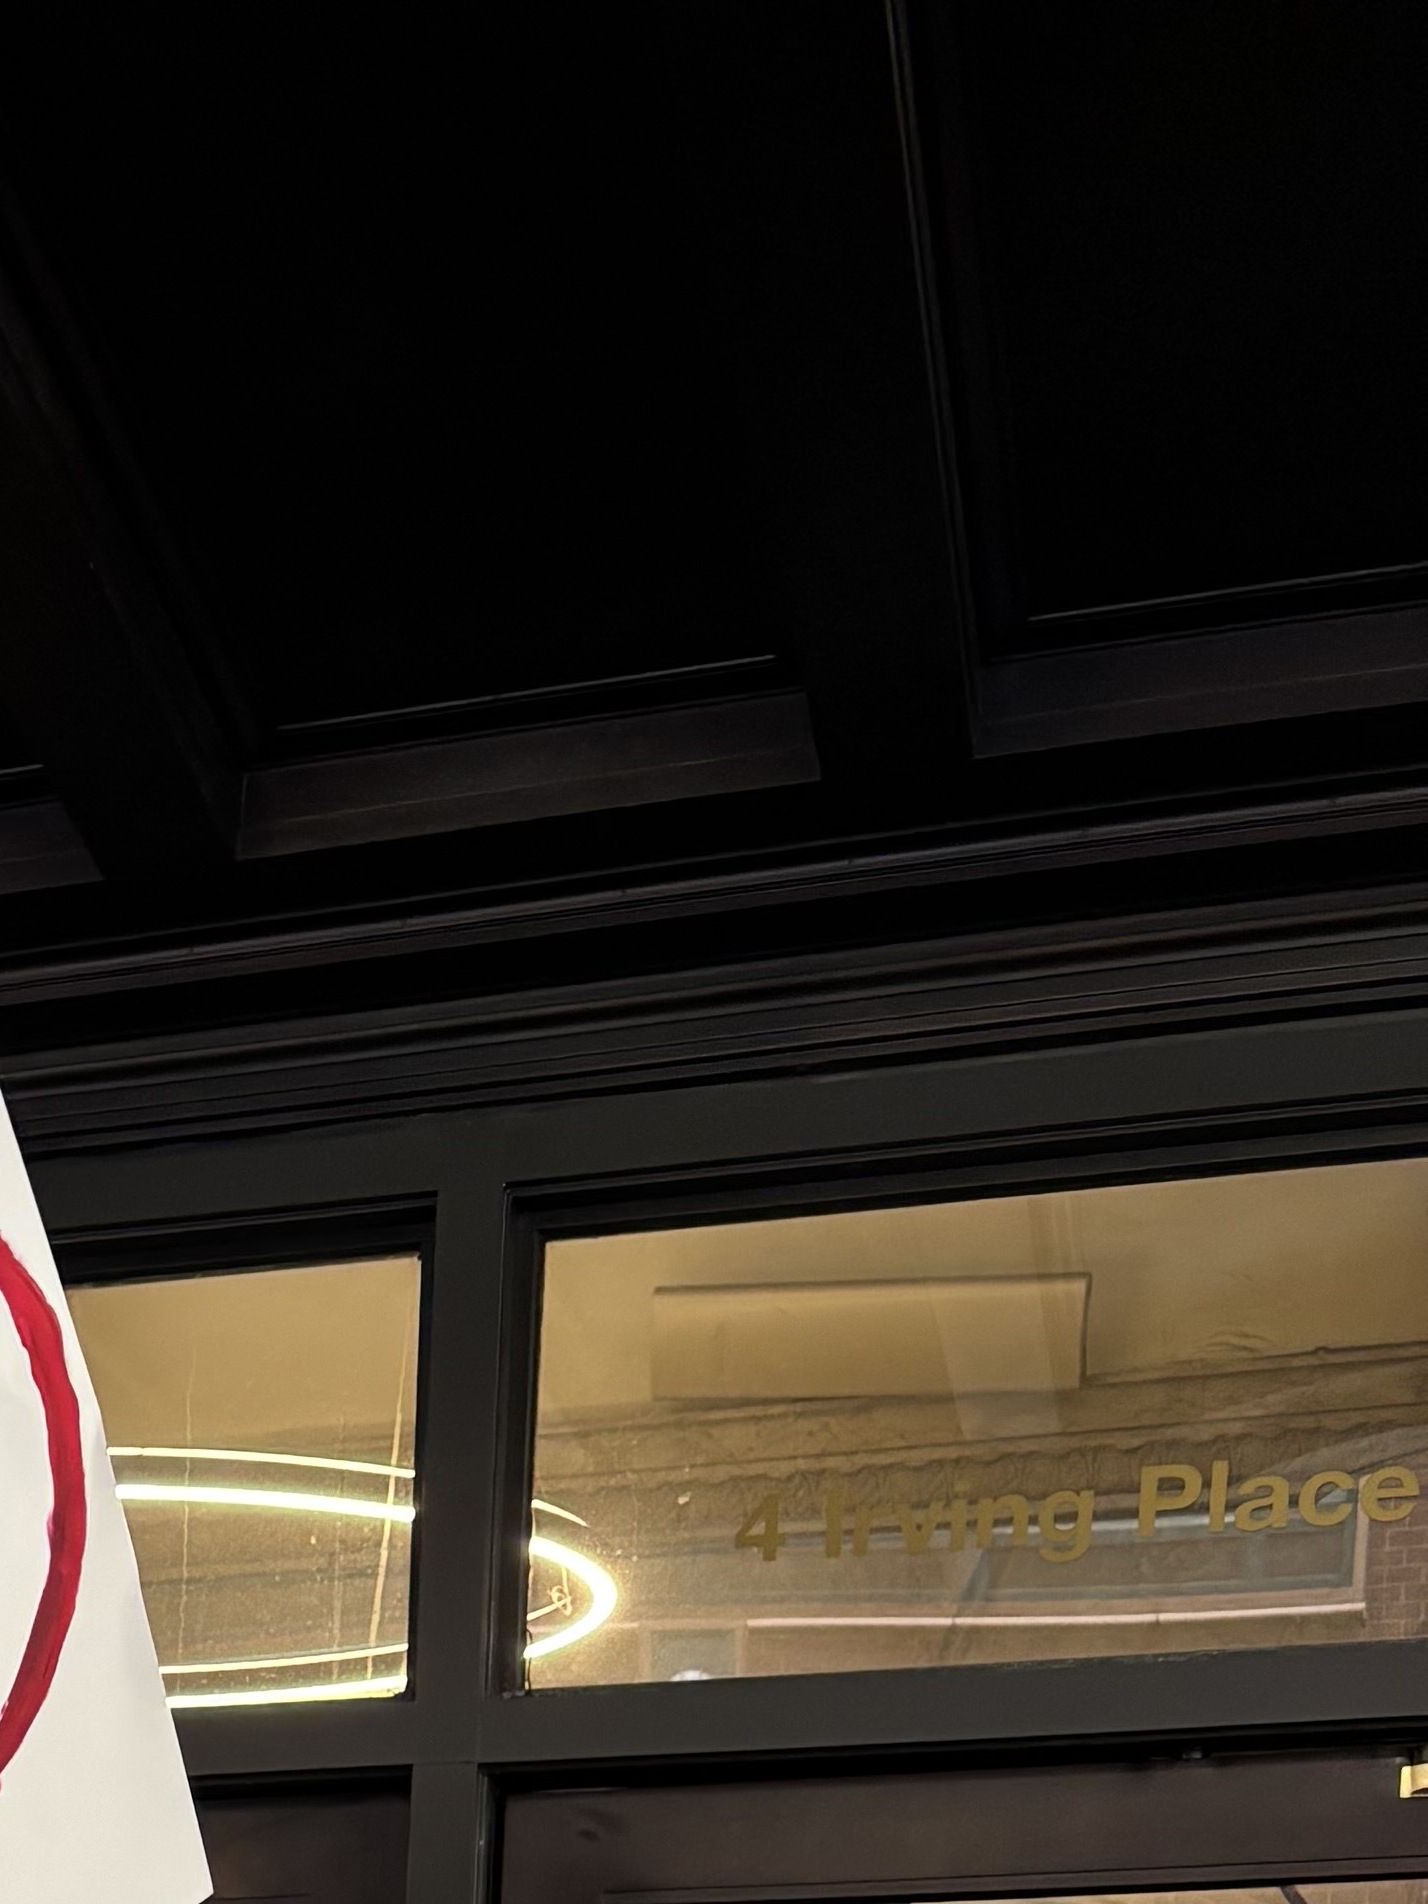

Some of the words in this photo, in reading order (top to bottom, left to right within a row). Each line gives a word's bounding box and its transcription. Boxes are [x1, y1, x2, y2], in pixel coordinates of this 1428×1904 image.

[734, 1492, 787, 1562] 4
[823, 1476, 1096, 1563] Irving
[1138, 1460, 1421, 1536] Place
